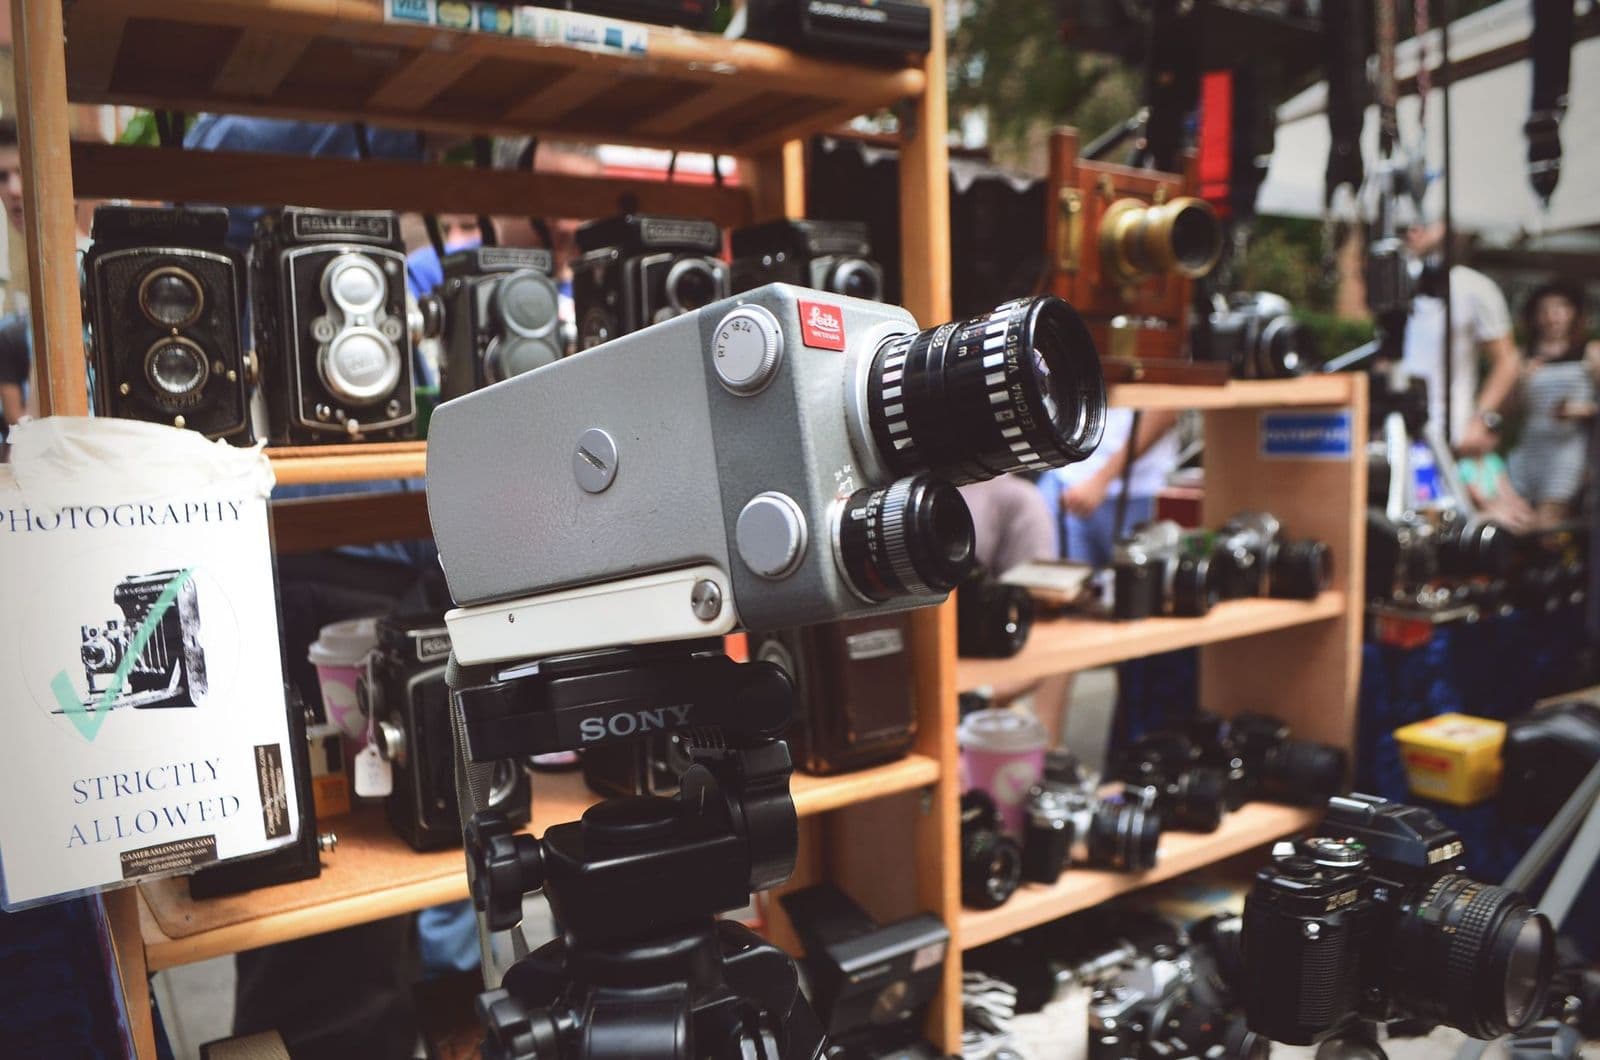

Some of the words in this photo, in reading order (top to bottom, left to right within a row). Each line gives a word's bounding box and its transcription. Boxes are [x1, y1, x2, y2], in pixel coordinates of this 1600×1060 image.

[808, 306, 840, 332] Leitz
[579, 703, 694, 742] SONY
[72, 757, 220, 805] STRICTLY
[67, 794, 241, 849] ALLOWED
